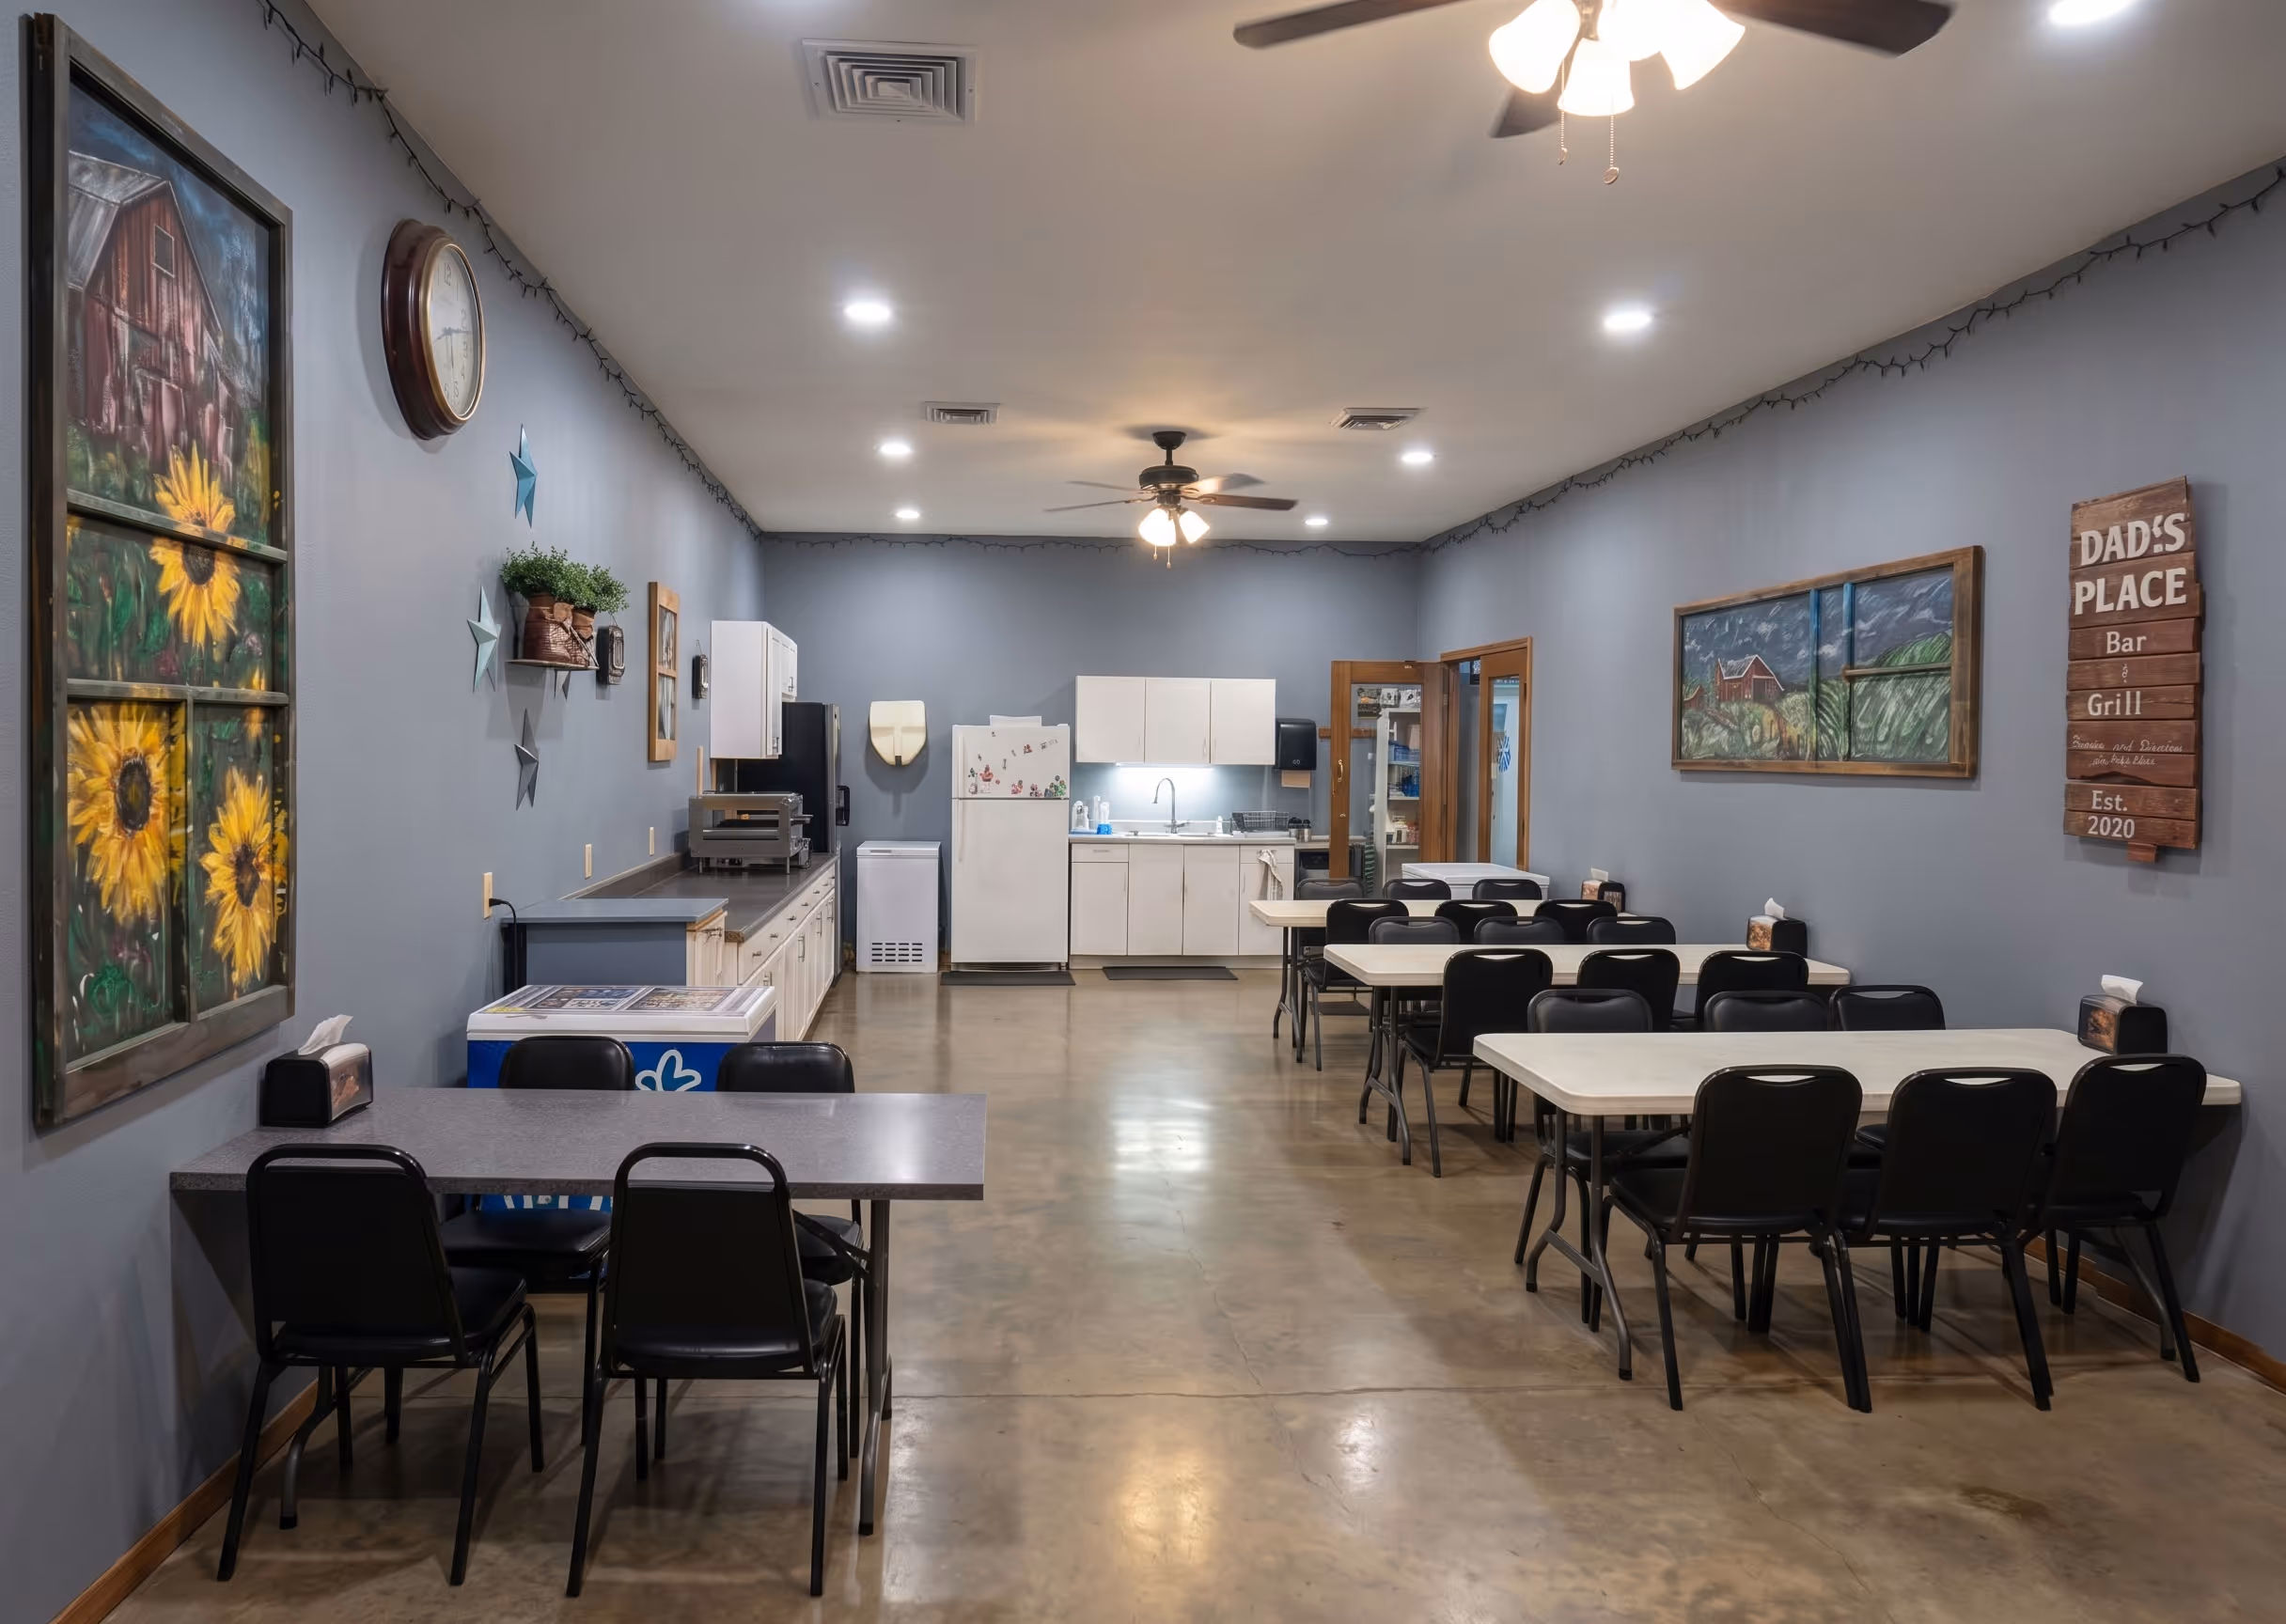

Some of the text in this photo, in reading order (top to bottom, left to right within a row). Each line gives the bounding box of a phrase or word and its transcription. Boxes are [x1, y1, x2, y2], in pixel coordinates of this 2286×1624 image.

[2075, 567, 2187, 616] PLACE
[2106, 631, 2147, 654] Bar
[2088, 691, 2141, 716] Grill
[2091, 789, 2128, 812] Est.
[2088, 816, 2136, 838] 2020
